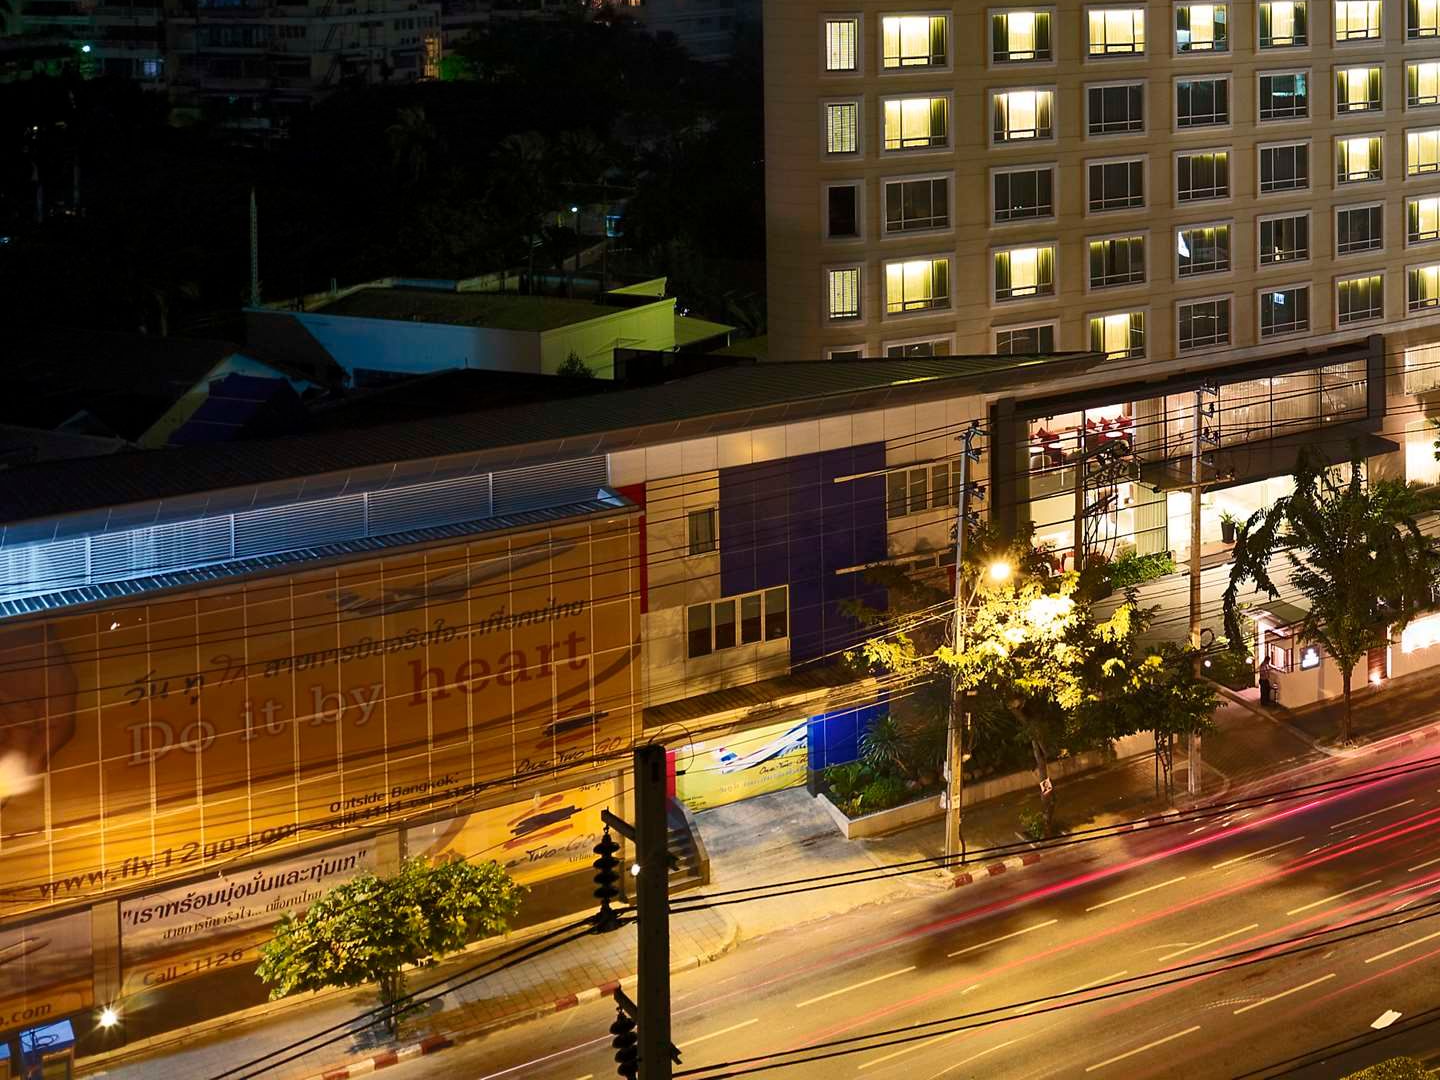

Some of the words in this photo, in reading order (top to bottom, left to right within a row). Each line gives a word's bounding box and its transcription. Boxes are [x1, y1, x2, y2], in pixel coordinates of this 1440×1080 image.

[126, 720, 216, 767] Do
[240, 698, 286, 742] it
[310, 685, 384, 726] by
[407, 630, 588, 708] heart
[329, 788, 387, 813] Outside
[39, 822, 299, 898] www.fly12go.com
[195, 949, 244, 972] 1126
